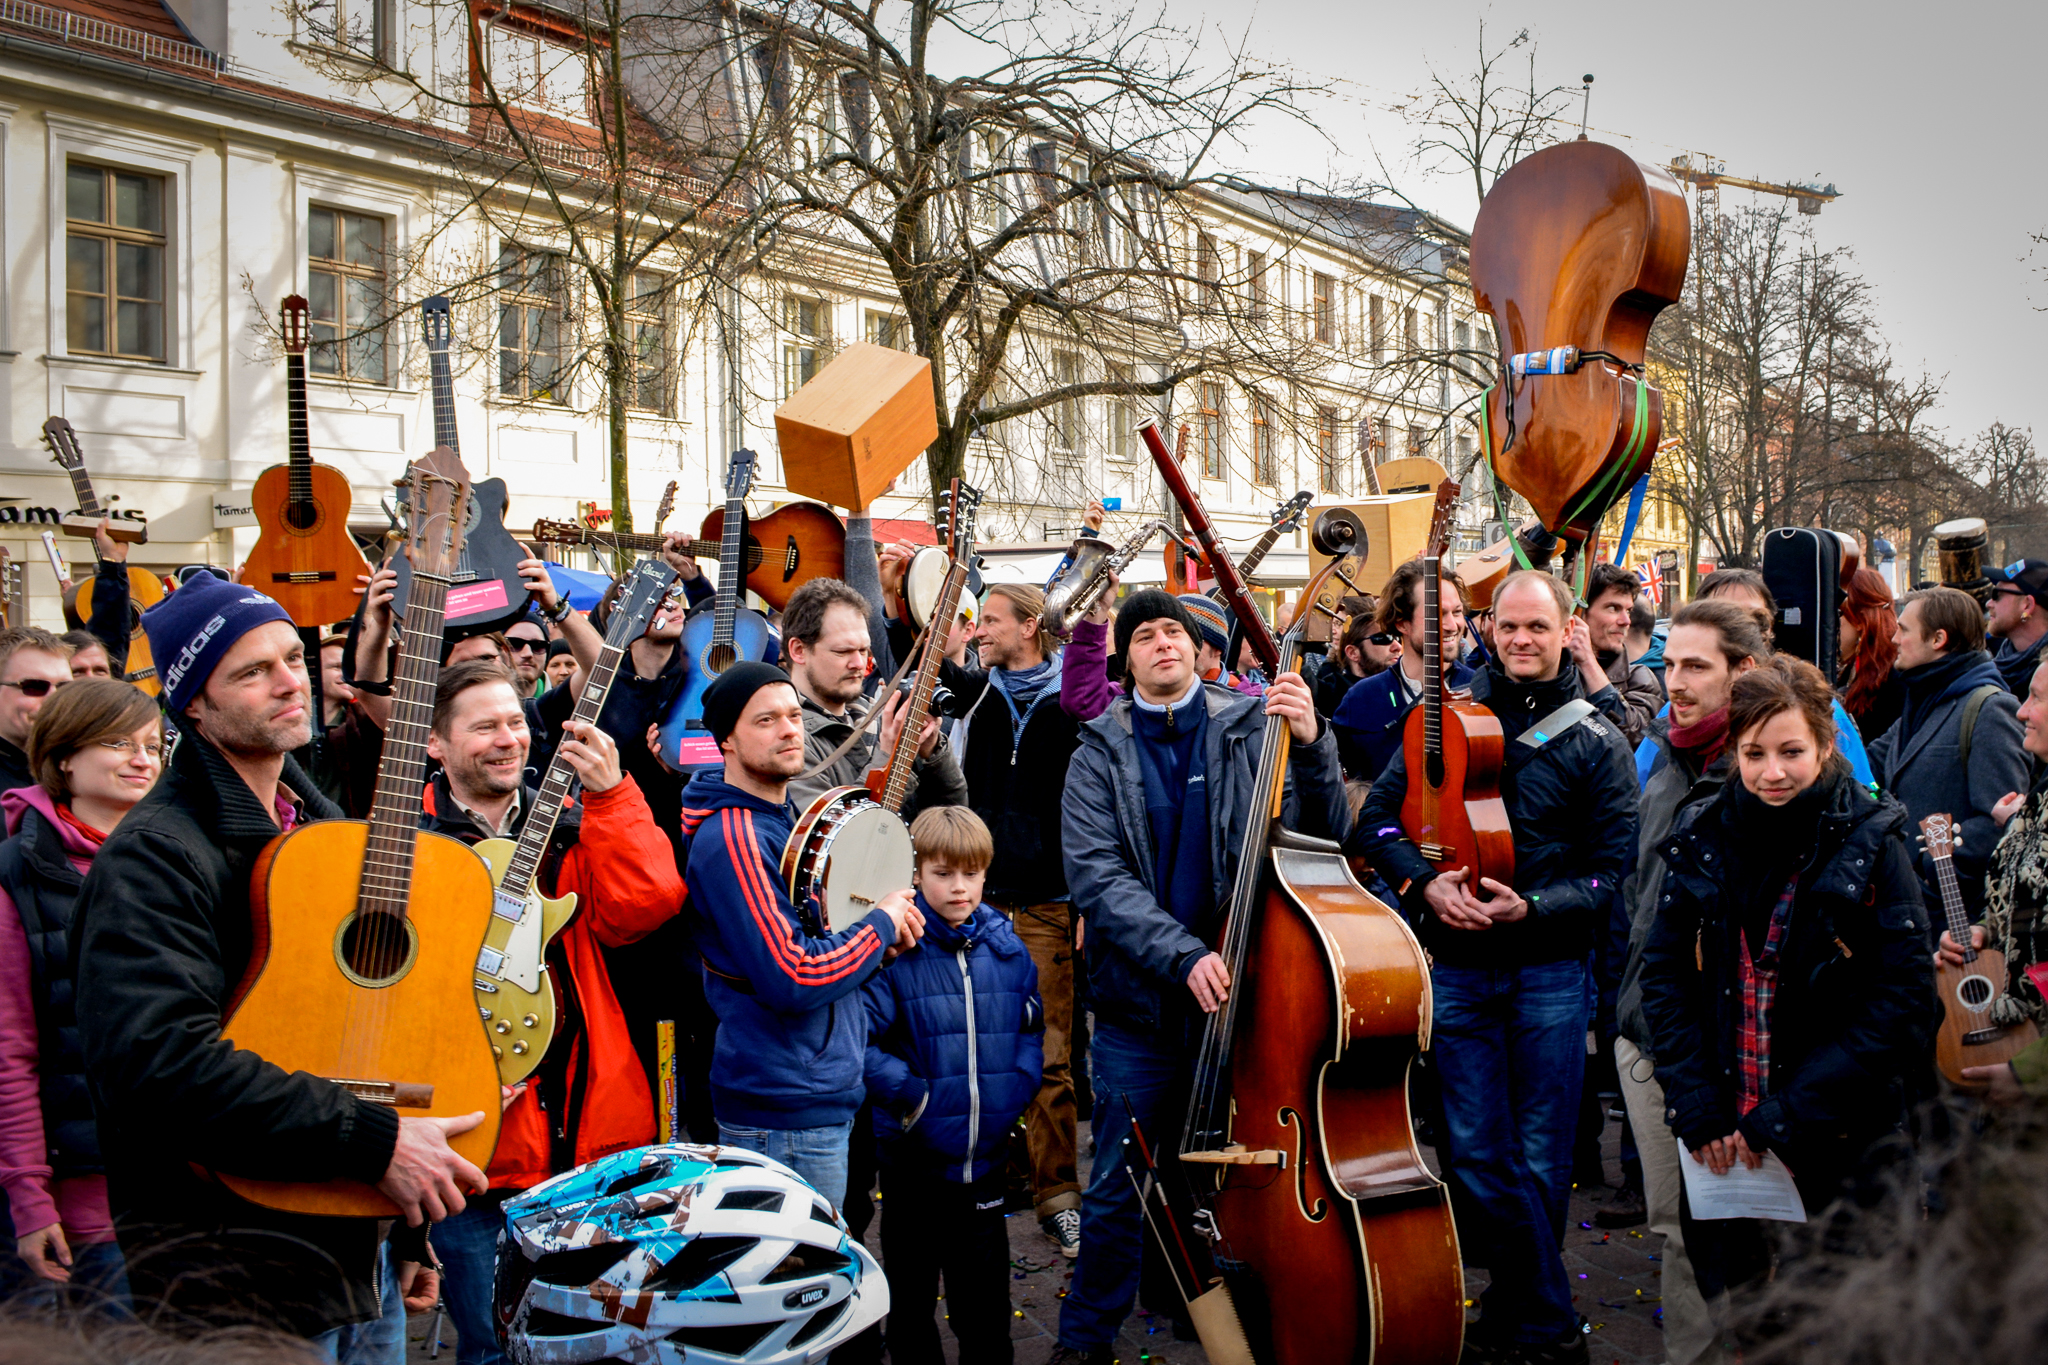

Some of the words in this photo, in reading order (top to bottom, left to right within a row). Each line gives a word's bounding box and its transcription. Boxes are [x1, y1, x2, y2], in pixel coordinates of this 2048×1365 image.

[214, 504, 254, 517] Tamar
[556, 1200, 588, 1213] uvex
[801, 1289, 823, 1304] uvex
